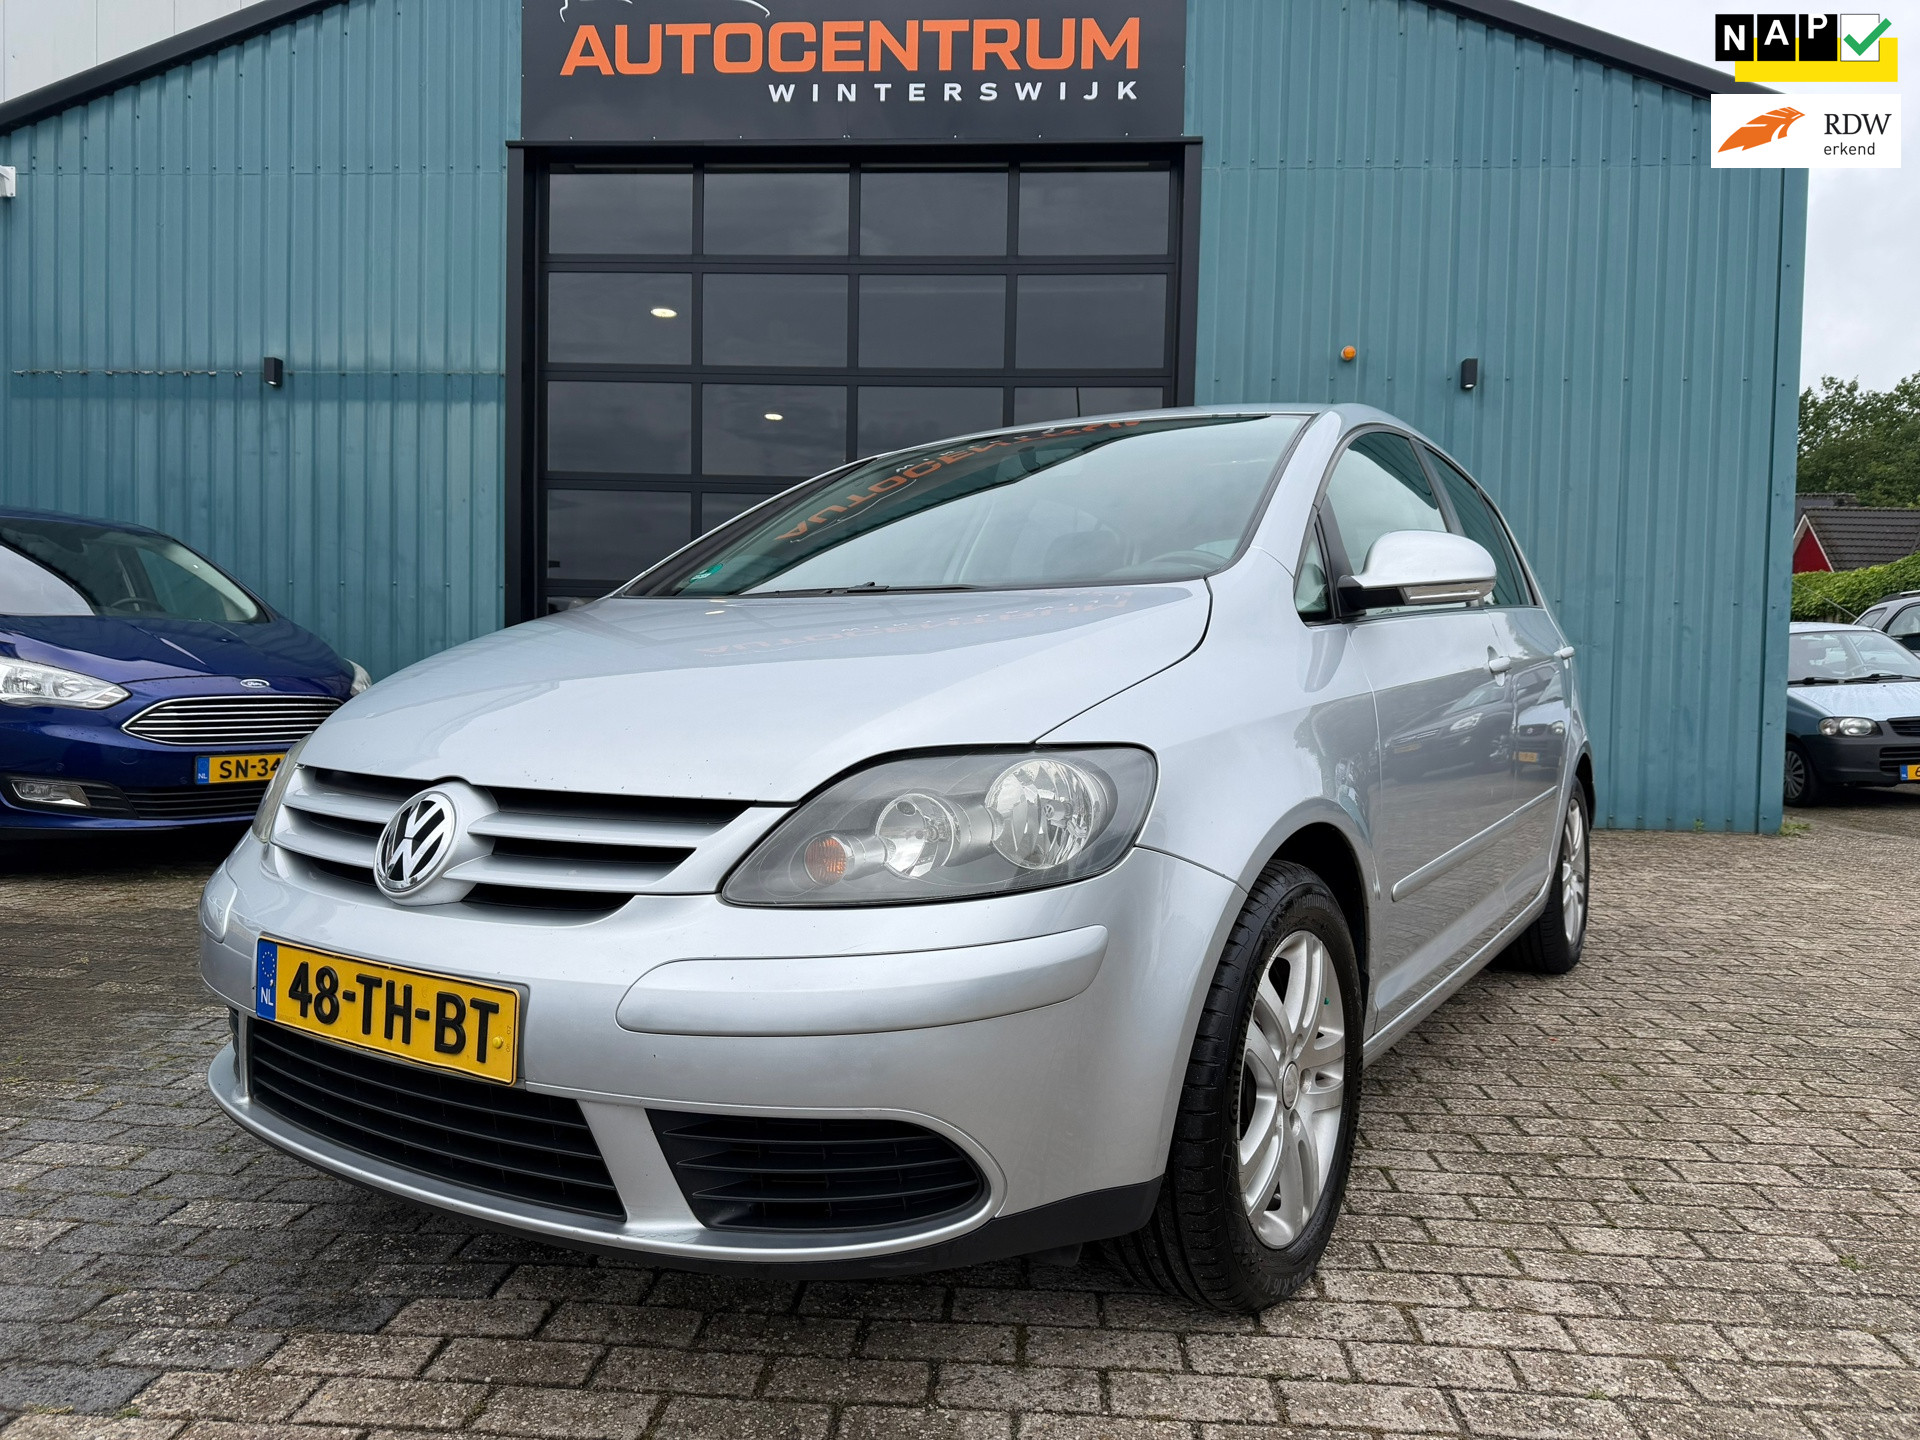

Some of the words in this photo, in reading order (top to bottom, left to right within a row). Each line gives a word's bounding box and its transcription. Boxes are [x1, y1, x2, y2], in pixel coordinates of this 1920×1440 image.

[560, 17, 1140, 75] AUTOCENTRUM
[768, 81, 1138, 102] WINTERSWIJK
[260, 986, 274, 1006] NL
[288, 961, 500, 1064] 48-TH-BT
